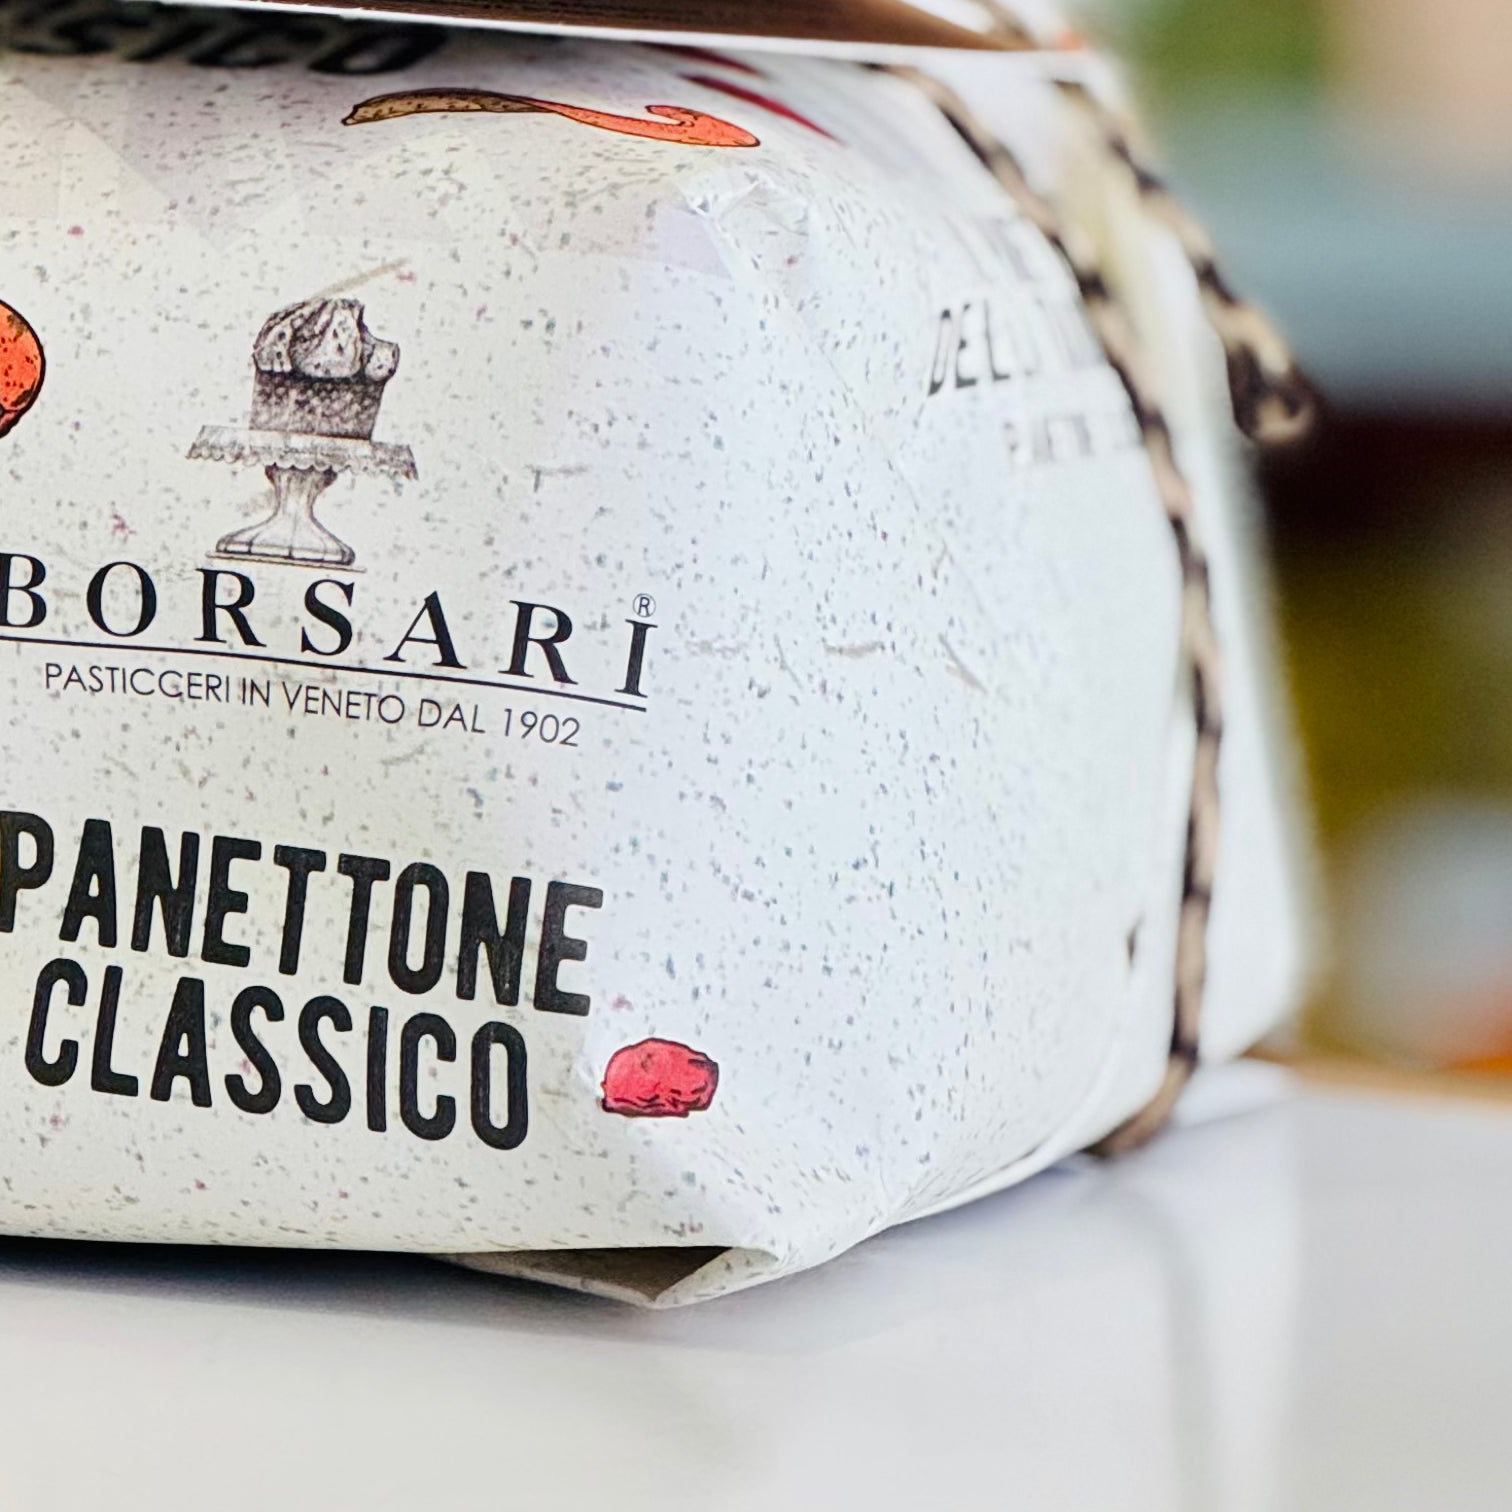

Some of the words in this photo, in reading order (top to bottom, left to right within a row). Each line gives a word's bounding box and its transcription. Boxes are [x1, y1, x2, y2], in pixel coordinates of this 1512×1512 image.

[45, 662, 230, 703] PASTICCERI
[241, 677, 271, 707] IN
[281, 680, 406, 724] VENETO
[417, 697, 486, 734] DAL
[503, 707, 581, 748] 1902
[24, 958, 530, 1151] CLASSICO
